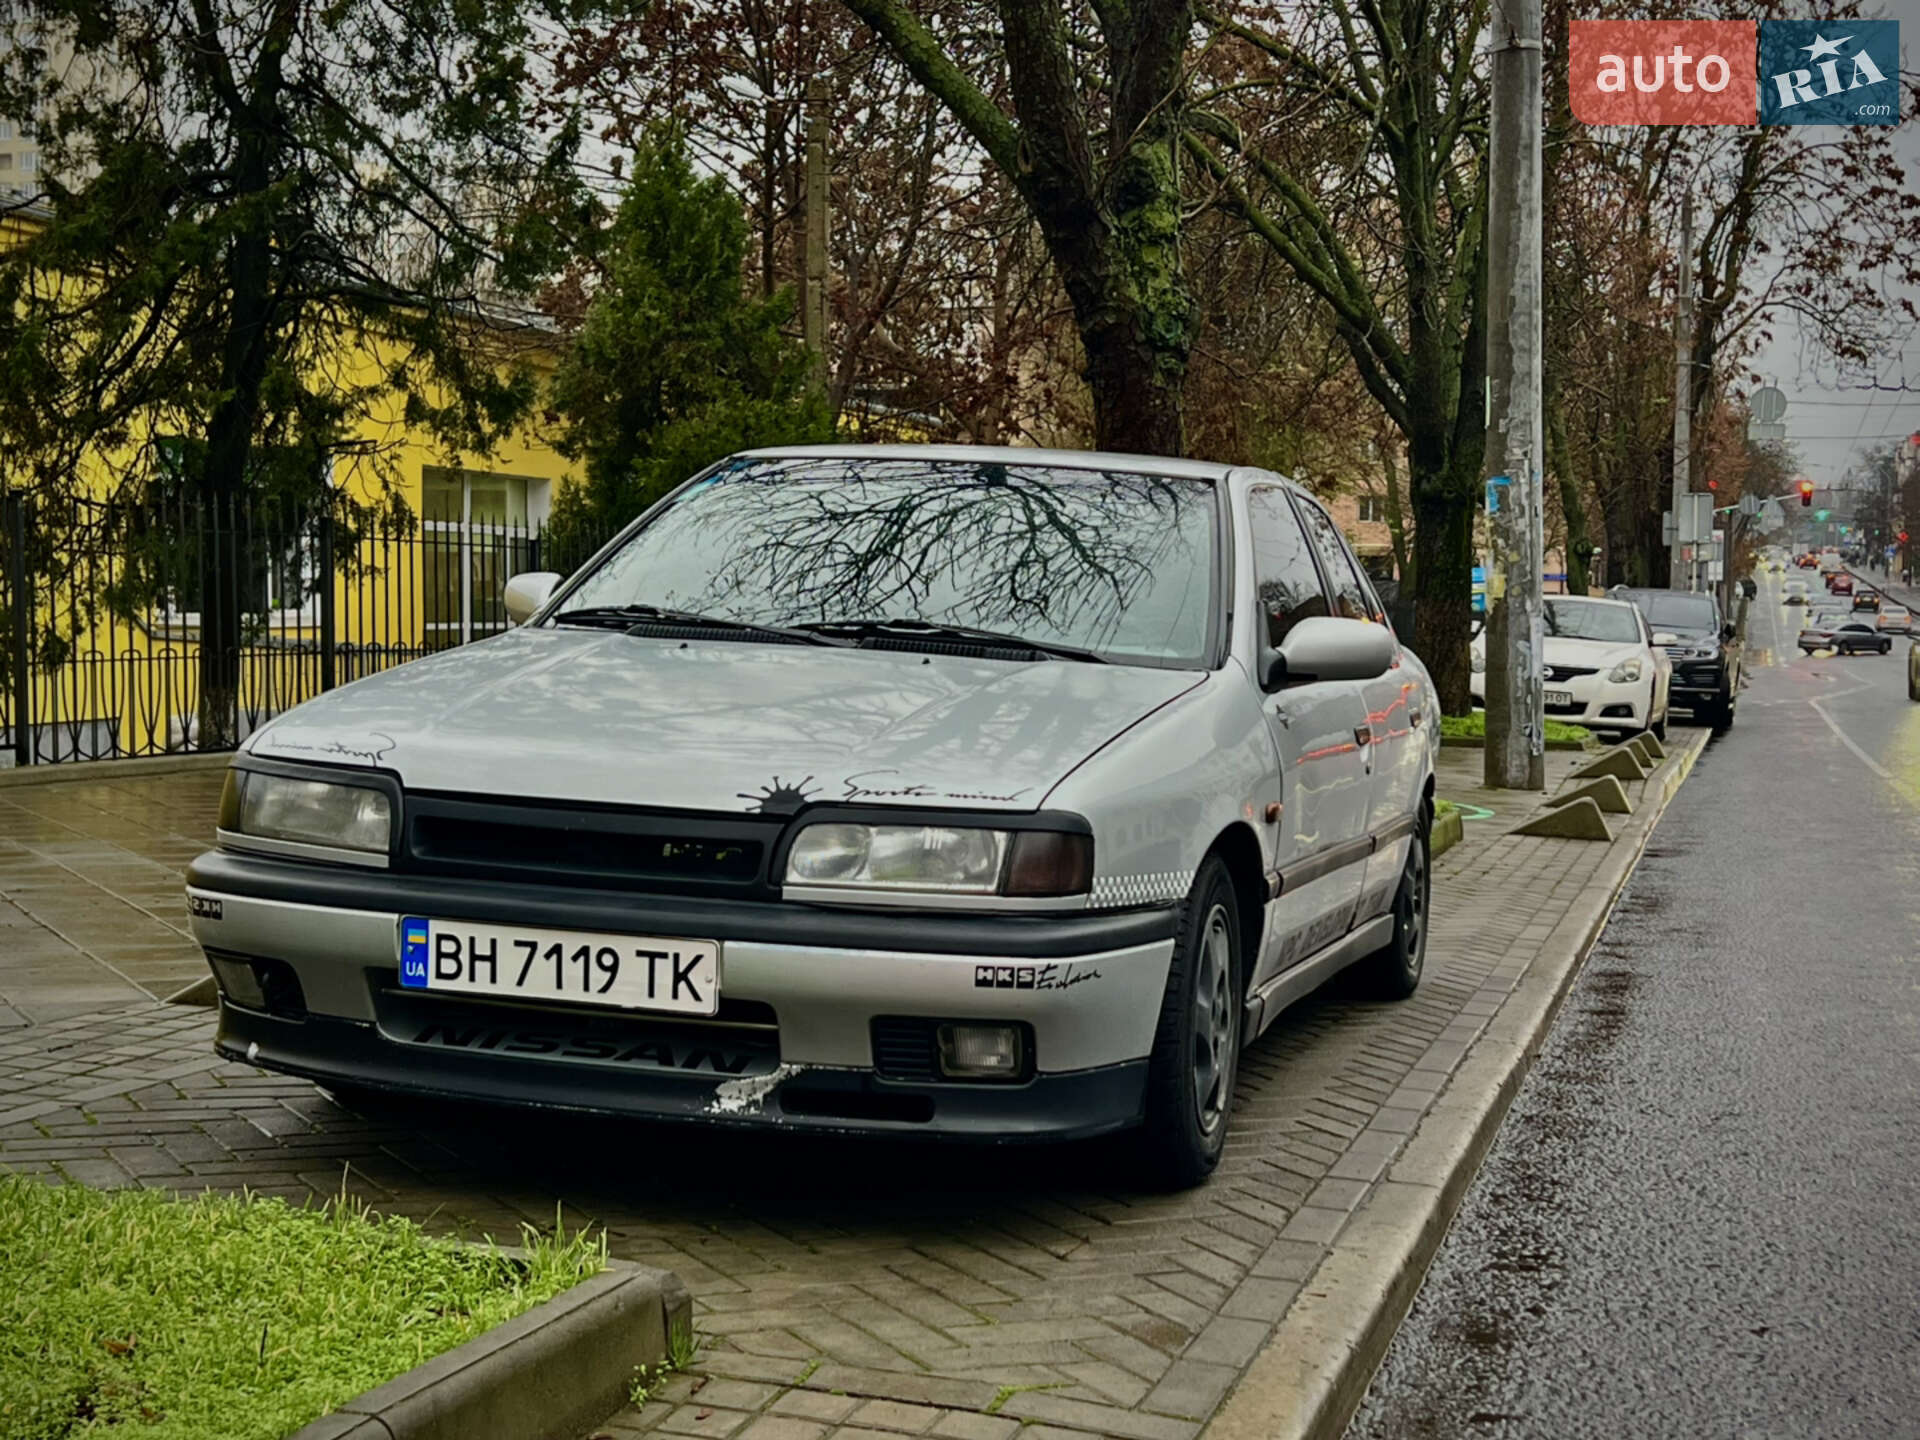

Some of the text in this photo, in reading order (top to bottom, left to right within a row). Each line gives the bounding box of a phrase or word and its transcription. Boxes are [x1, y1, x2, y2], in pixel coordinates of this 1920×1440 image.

[842, 770, 938, 802] Sports
[405, 933, 704, 1002] UA BH 7119 TK
[975, 966, 1035, 987] HKS
[412, 1024, 756, 1075] NISSAN
